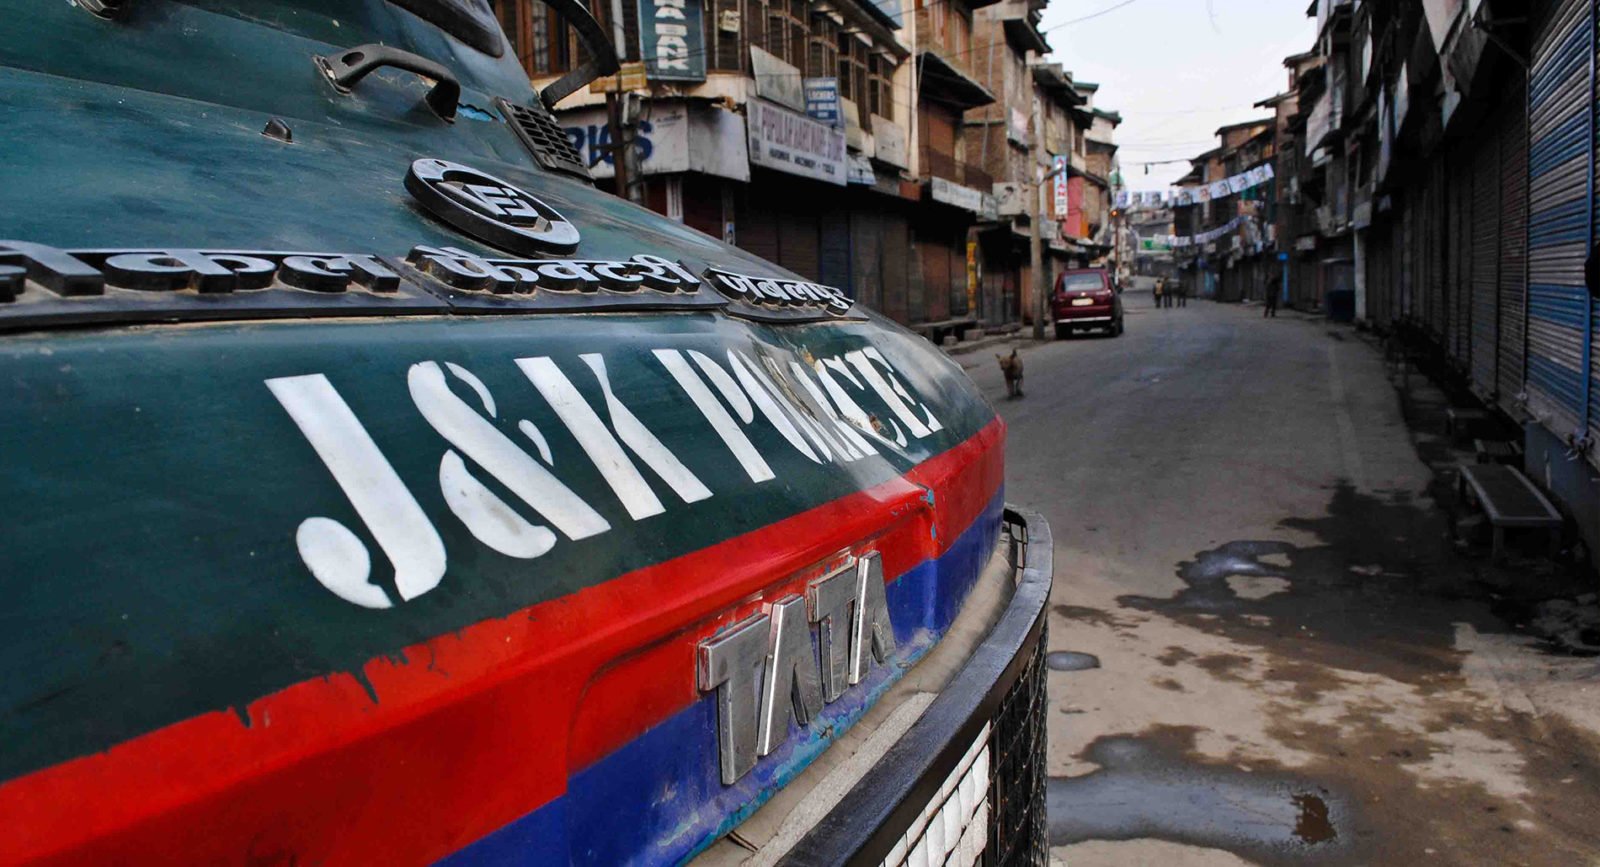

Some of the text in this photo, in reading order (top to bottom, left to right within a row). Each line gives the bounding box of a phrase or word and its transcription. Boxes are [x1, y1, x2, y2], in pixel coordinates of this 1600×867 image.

[264, 347, 944, 608] J&K POLICE
[697, 550, 897, 785] TATA
